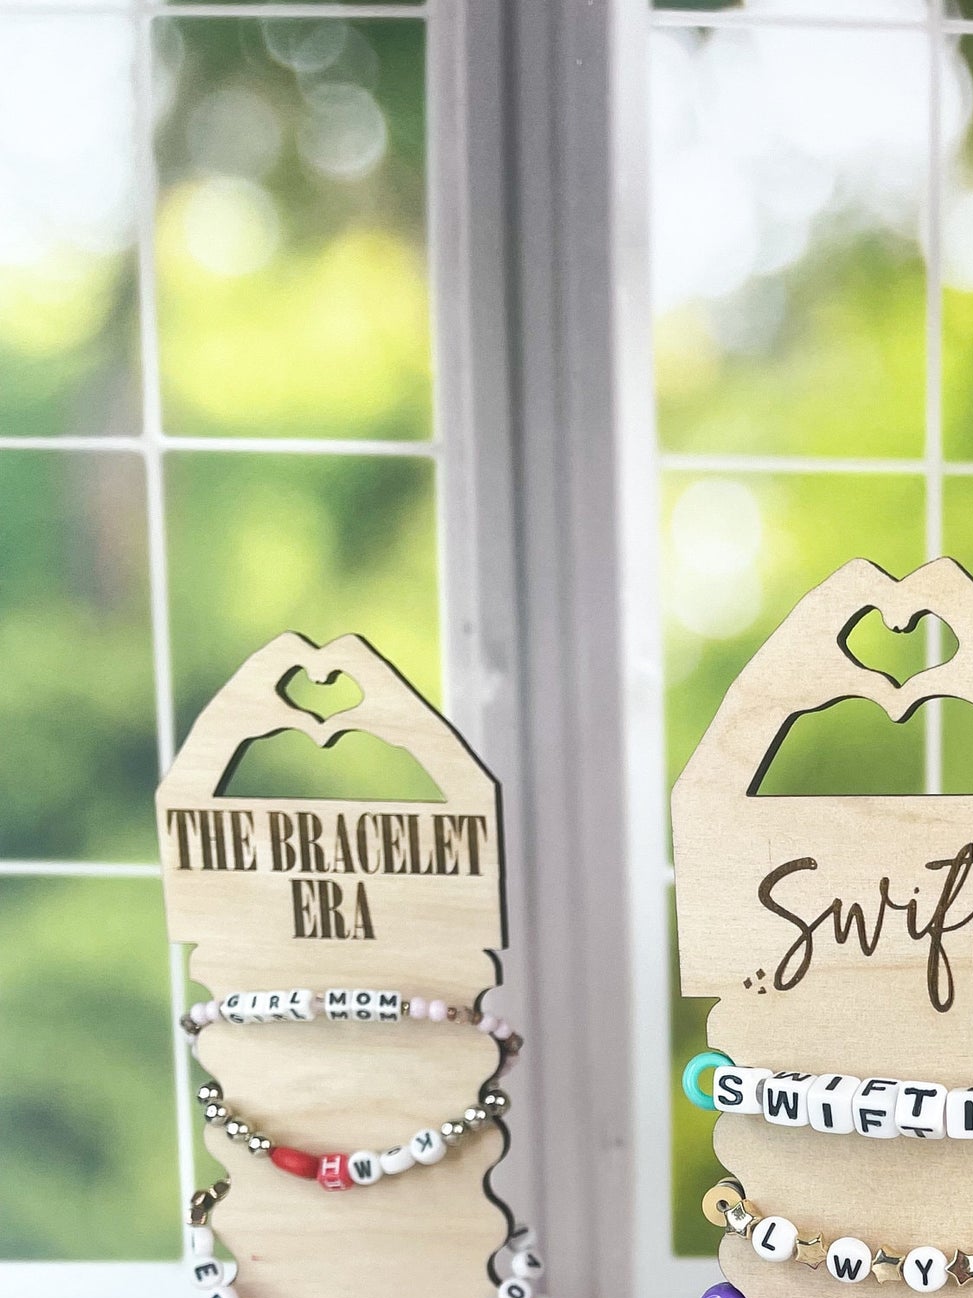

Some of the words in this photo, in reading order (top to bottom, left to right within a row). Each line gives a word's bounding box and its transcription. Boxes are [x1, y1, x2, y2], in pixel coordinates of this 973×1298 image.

[167, 809, 257, 872] THE
[265, 811, 488, 876] BRACELET
[289, 879, 376, 940] ERA
